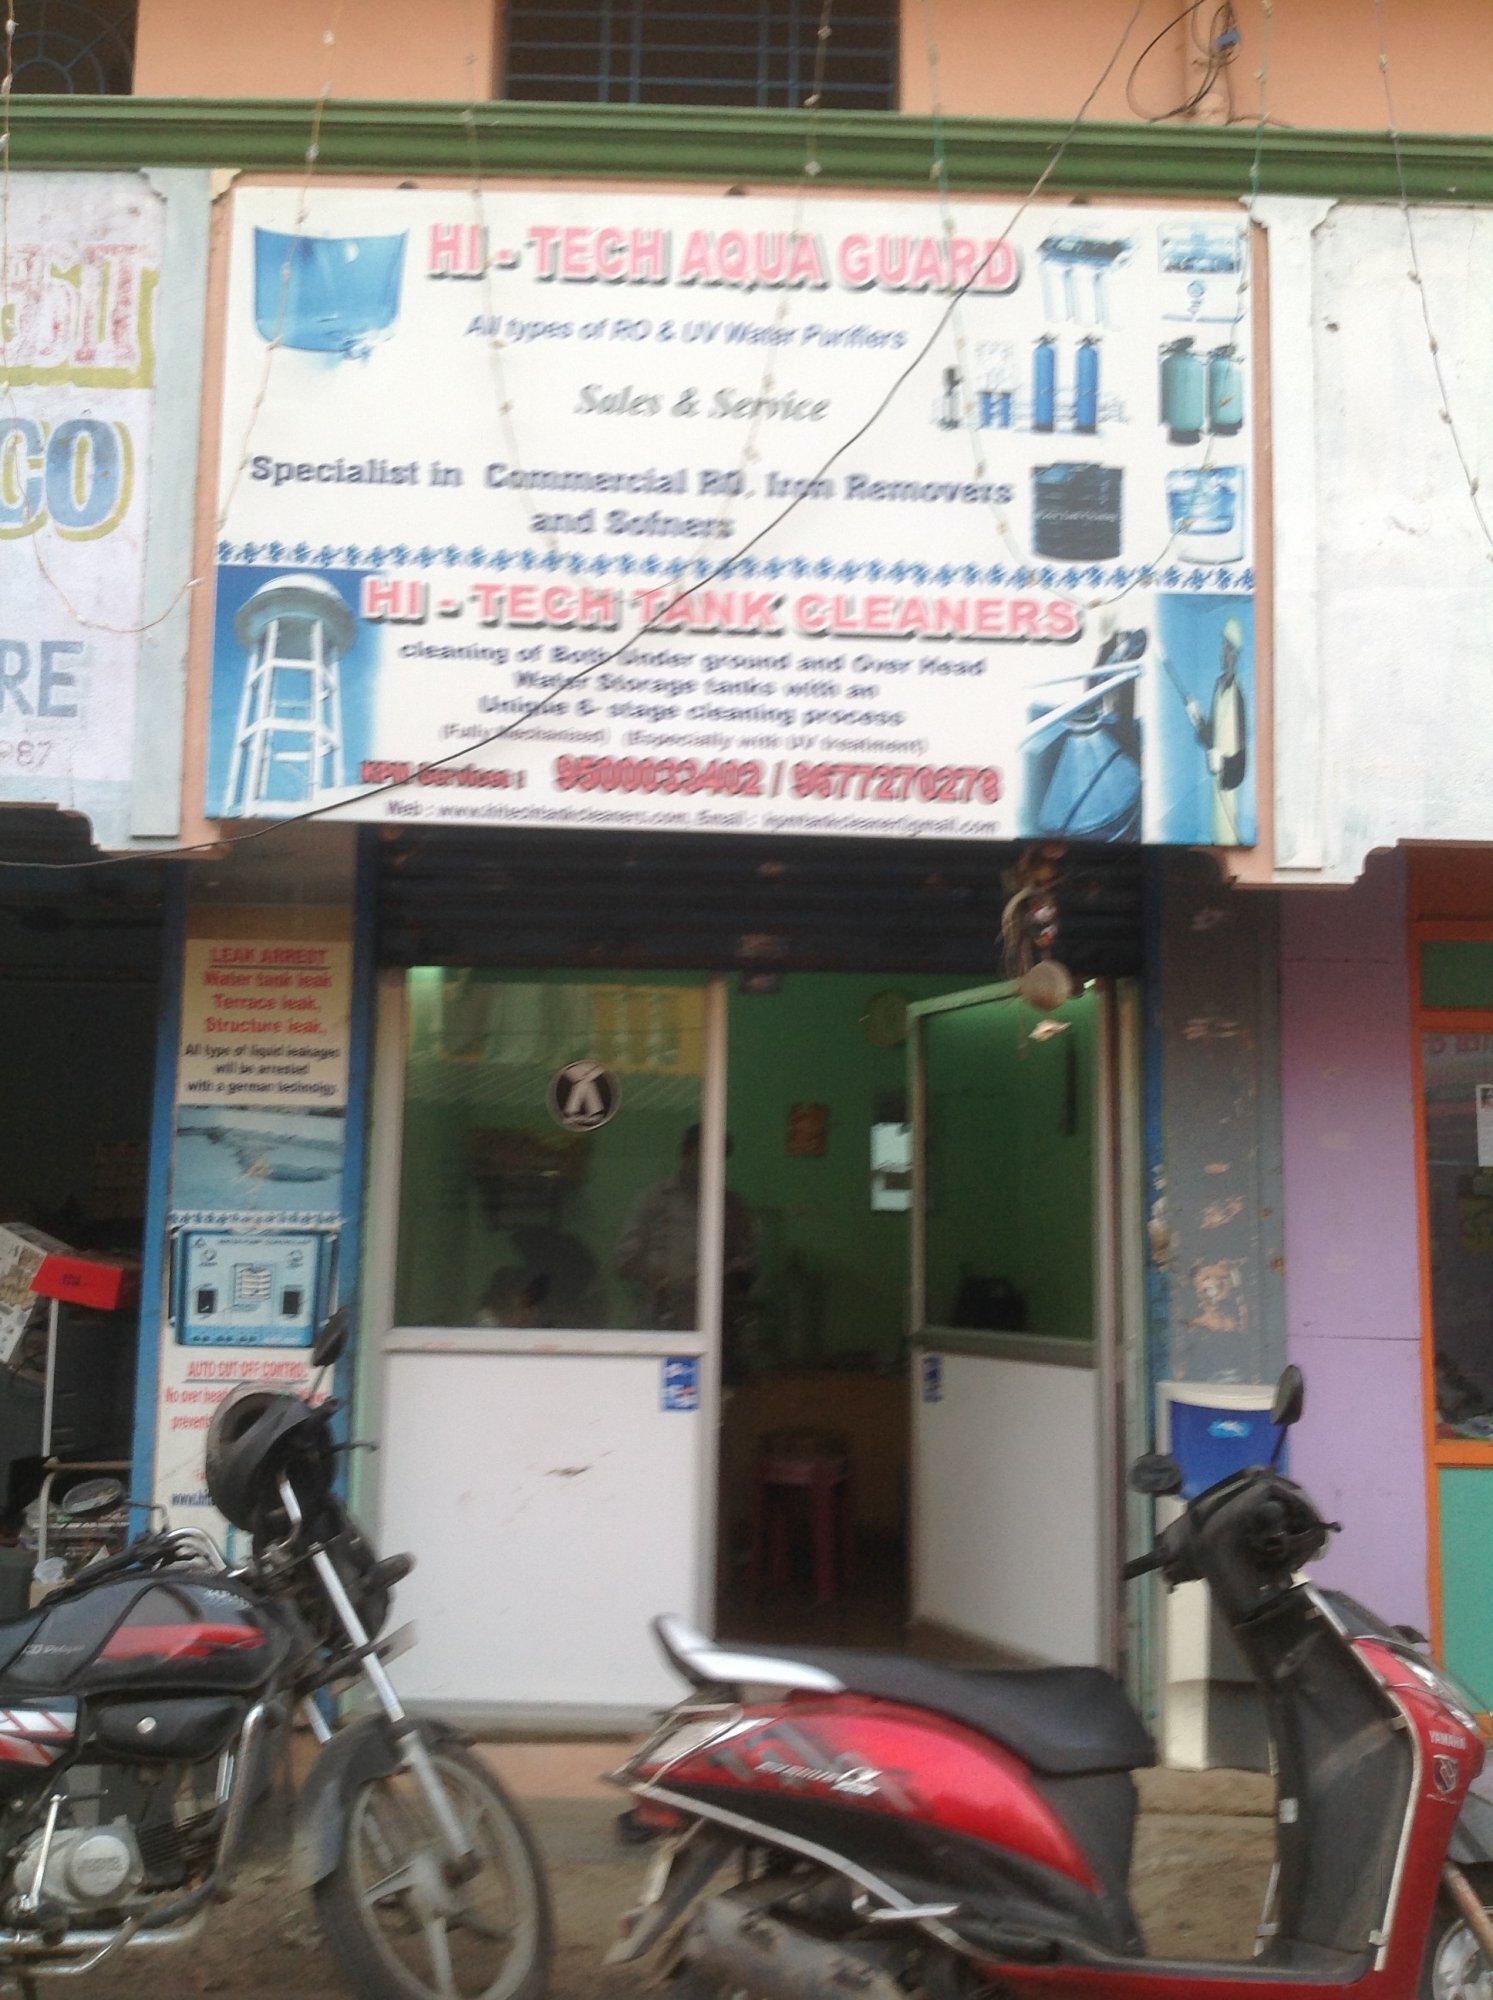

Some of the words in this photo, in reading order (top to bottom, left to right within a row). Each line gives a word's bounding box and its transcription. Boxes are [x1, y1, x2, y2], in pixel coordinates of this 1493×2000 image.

[427, 222, 488, 279] HI
[528, 225, 670, 286] TECH
[676, 228, 829, 293] AQUA
[837, 233, 1022, 295] GUARD
[466, 315, 503, 338] All
[506, 318, 574, 346] types
[578, 319, 609, 342] of
[612, 318, 651, 343] RO
[656, 319, 676, 342] &
[680, 320, 724, 344] UV
[724, 322, 797, 347] Water
[800, 322, 910, 351] Purifiers
[574, 383, 665, 417] Sales
[670, 386, 702, 417] &
[707, 387, 832, 422] Service
[250, 455, 421, 487] Specialist
[429, 461, 464, 487] in
[484, 461, 687, 496] Commercial
[765, 469, 836, 500] Iron
[842, 471, 1018, 505] Removers
[530, 508, 596, 536] and
[361, 574, 427, 626] HI
[470, 579, 624, 634] TECH
[630, 584, 788, 639] TANK
[790, 590, 1083, 646] CLEANERS
[515, 644, 544, 663] of
[615, 648, 696, 669] Under
[700, 652, 792, 673] ground
[797, 654, 847, 673] and
[850, 653, 914, 674] Over
[917, 656, 988, 677] Head
[514, 669, 592, 690] Water
[596, 673, 699, 698] Storage
[702, 676, 779, 698] tanks
[782, 678, 843, 699] with
[845, 683, 880, 700] an
[606, 701, 681, 723] stage
[800, 708, 908, 728] process
